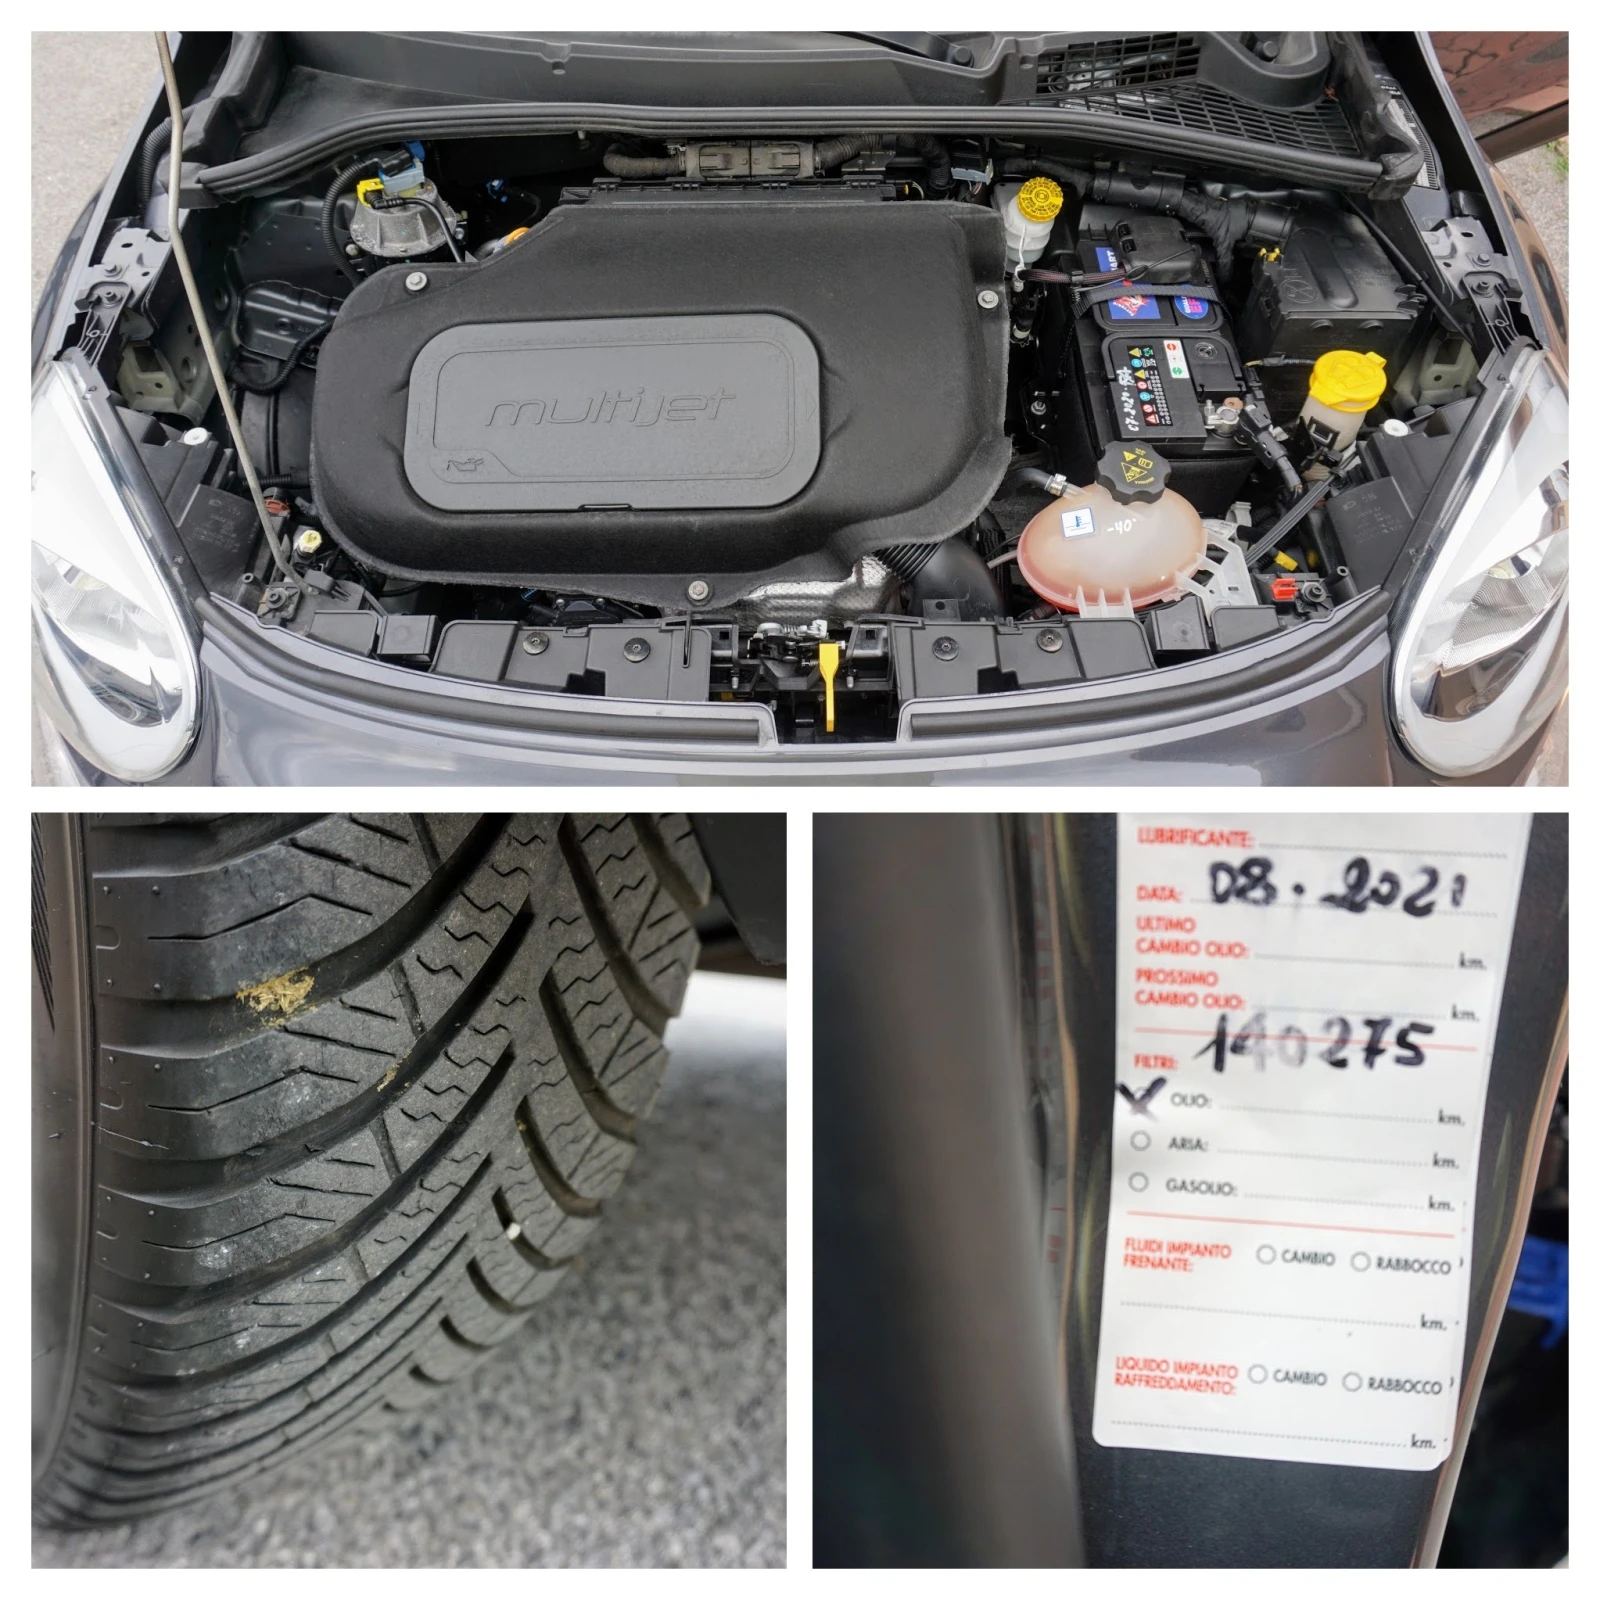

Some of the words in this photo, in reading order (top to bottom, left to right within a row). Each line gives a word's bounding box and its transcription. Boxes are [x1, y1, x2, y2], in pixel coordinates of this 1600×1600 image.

[1187, 297, 1204, 313] EF
[485, 386, 736, 427] multijet
[1136, 826, 1256, 849] LUBRIFICANTE:
[1136, 884, 1183, 903] DATA:
[1136, 915, 1197, 934] ULTIMO
[1135, 937, 1201, 956] CAMBIO
[1204, 940, 1250, 959] OLIO:
[1458, 951, 1488, 970] km.
[1135, 968, 1219, 987] PROSSIMO
[1135, 989, 1200, 1008] CAMBIO
[1202, 992, 1246, 1010] OLIO:
[1451, 1003, 1480, 1022] km.
[1134, 1053, 1178, 1070] FILTRI:
[1170, 1091, 1212, 1109] OLIO:
[1437, 1109, 1466, 1127] km.
[1168, 1136, 1209, 1152] ARIA:
[1431, 1152, 1460, 1169] km.
[1165, 1176, 1238, 1197] GASOLIO:
[1427, 1195, 1455, 1212] km.
[1124, 1237, 1163, 1252] FLUIDI
[1167, 1241, 1232, 1259] IMPIANTO
[1123, 1254, 1194, 1272] FRENANTE:
[1281, 1249, 1336, 1267] CAMBIO
[1376, 1256, 1451, 1275] RABBOCCO
[1420, 1313, 1448, 1331] km.
[1115, 1356, 1169, 1373] LIQUIDO
[1173, 1360, 1239, 1379] IMPIANTO
[1273, 1368, 1328, 1386] CAMBIO
[1114, 1372, 1237, 1396] RAFFREDDAMENTO:
[1367, 1376, 1443, 1395] RABBOCCO
[1410, 1432, 1437, 1449] km.
